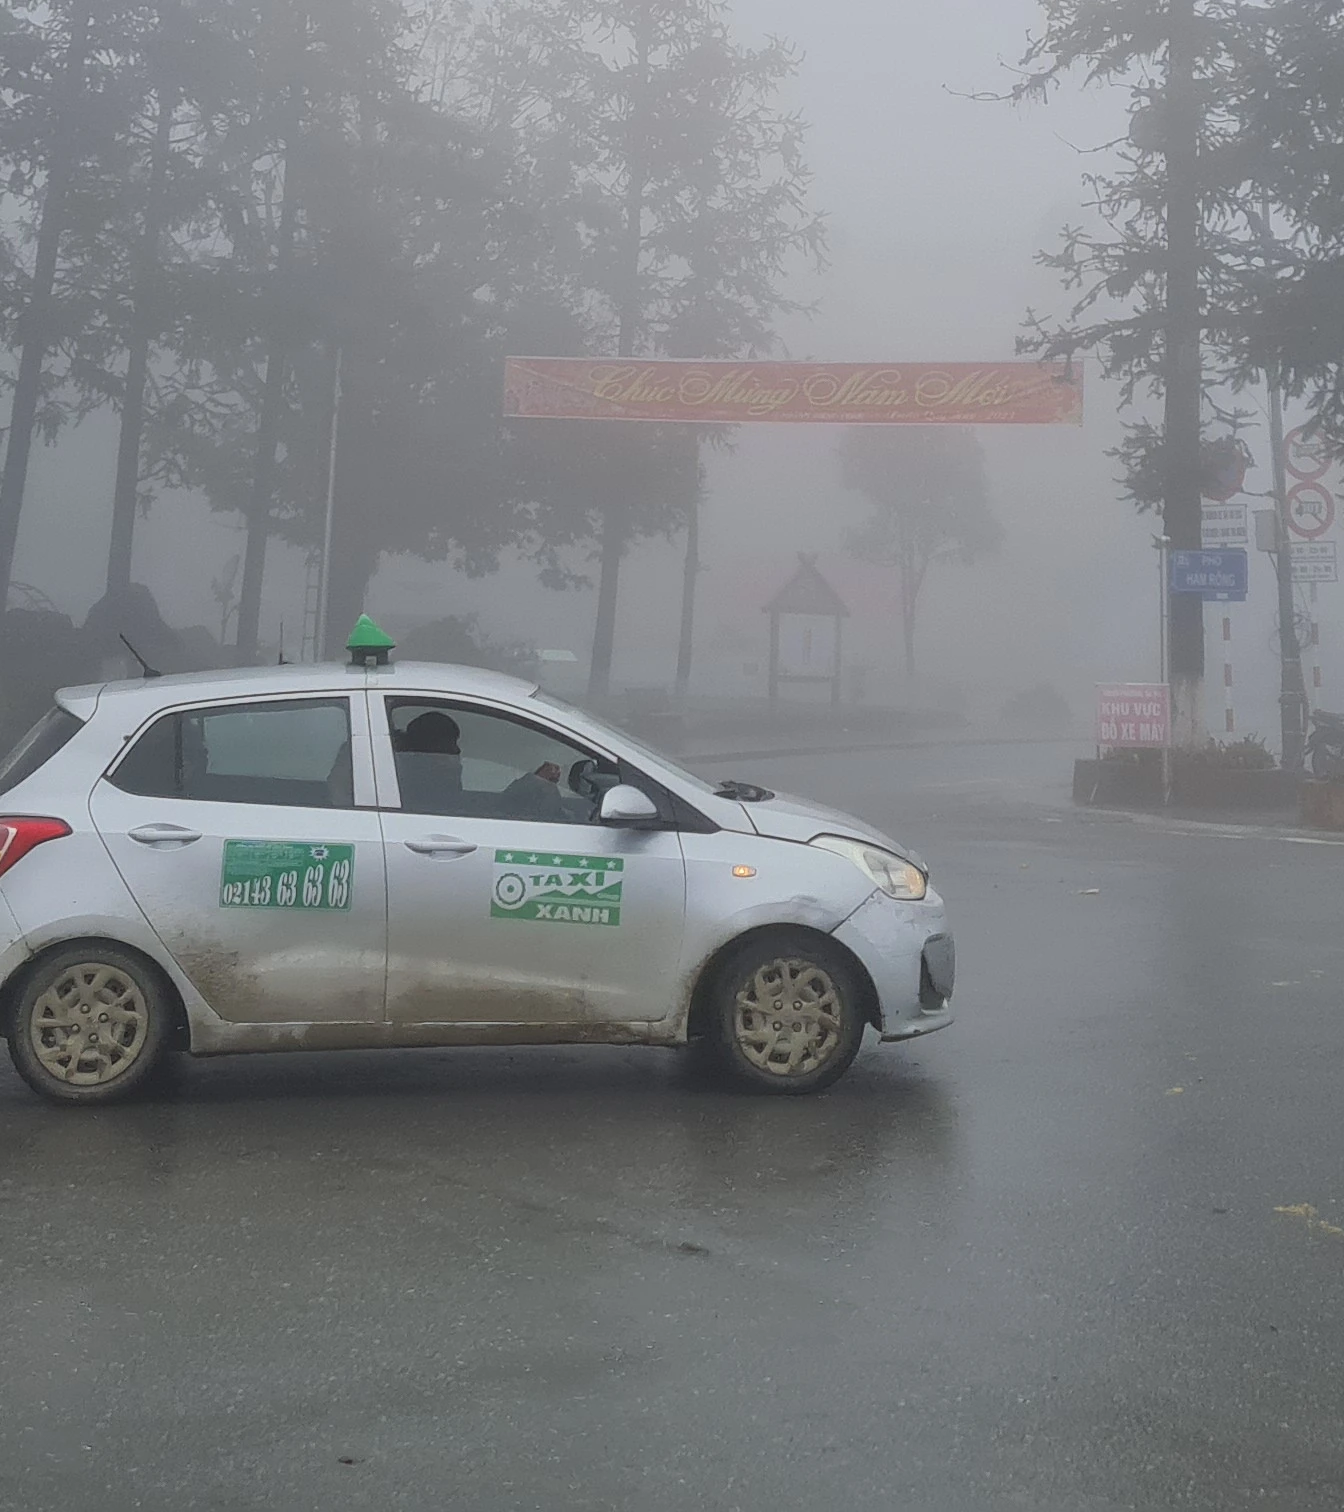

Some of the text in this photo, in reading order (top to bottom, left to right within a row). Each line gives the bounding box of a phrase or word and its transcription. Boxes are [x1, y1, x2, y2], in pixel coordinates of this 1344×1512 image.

[589, 365, 1013, 415] Chúc Mừng Năm Mới
[1101, 702, 1130, 716] KHU
[1121, 722, 1136, 741] XE
[223, 859, 350, 908] 02143 63 63 63
[528, 871, 605, 886] TAXI
[535, 903, 610, 923] XANH
